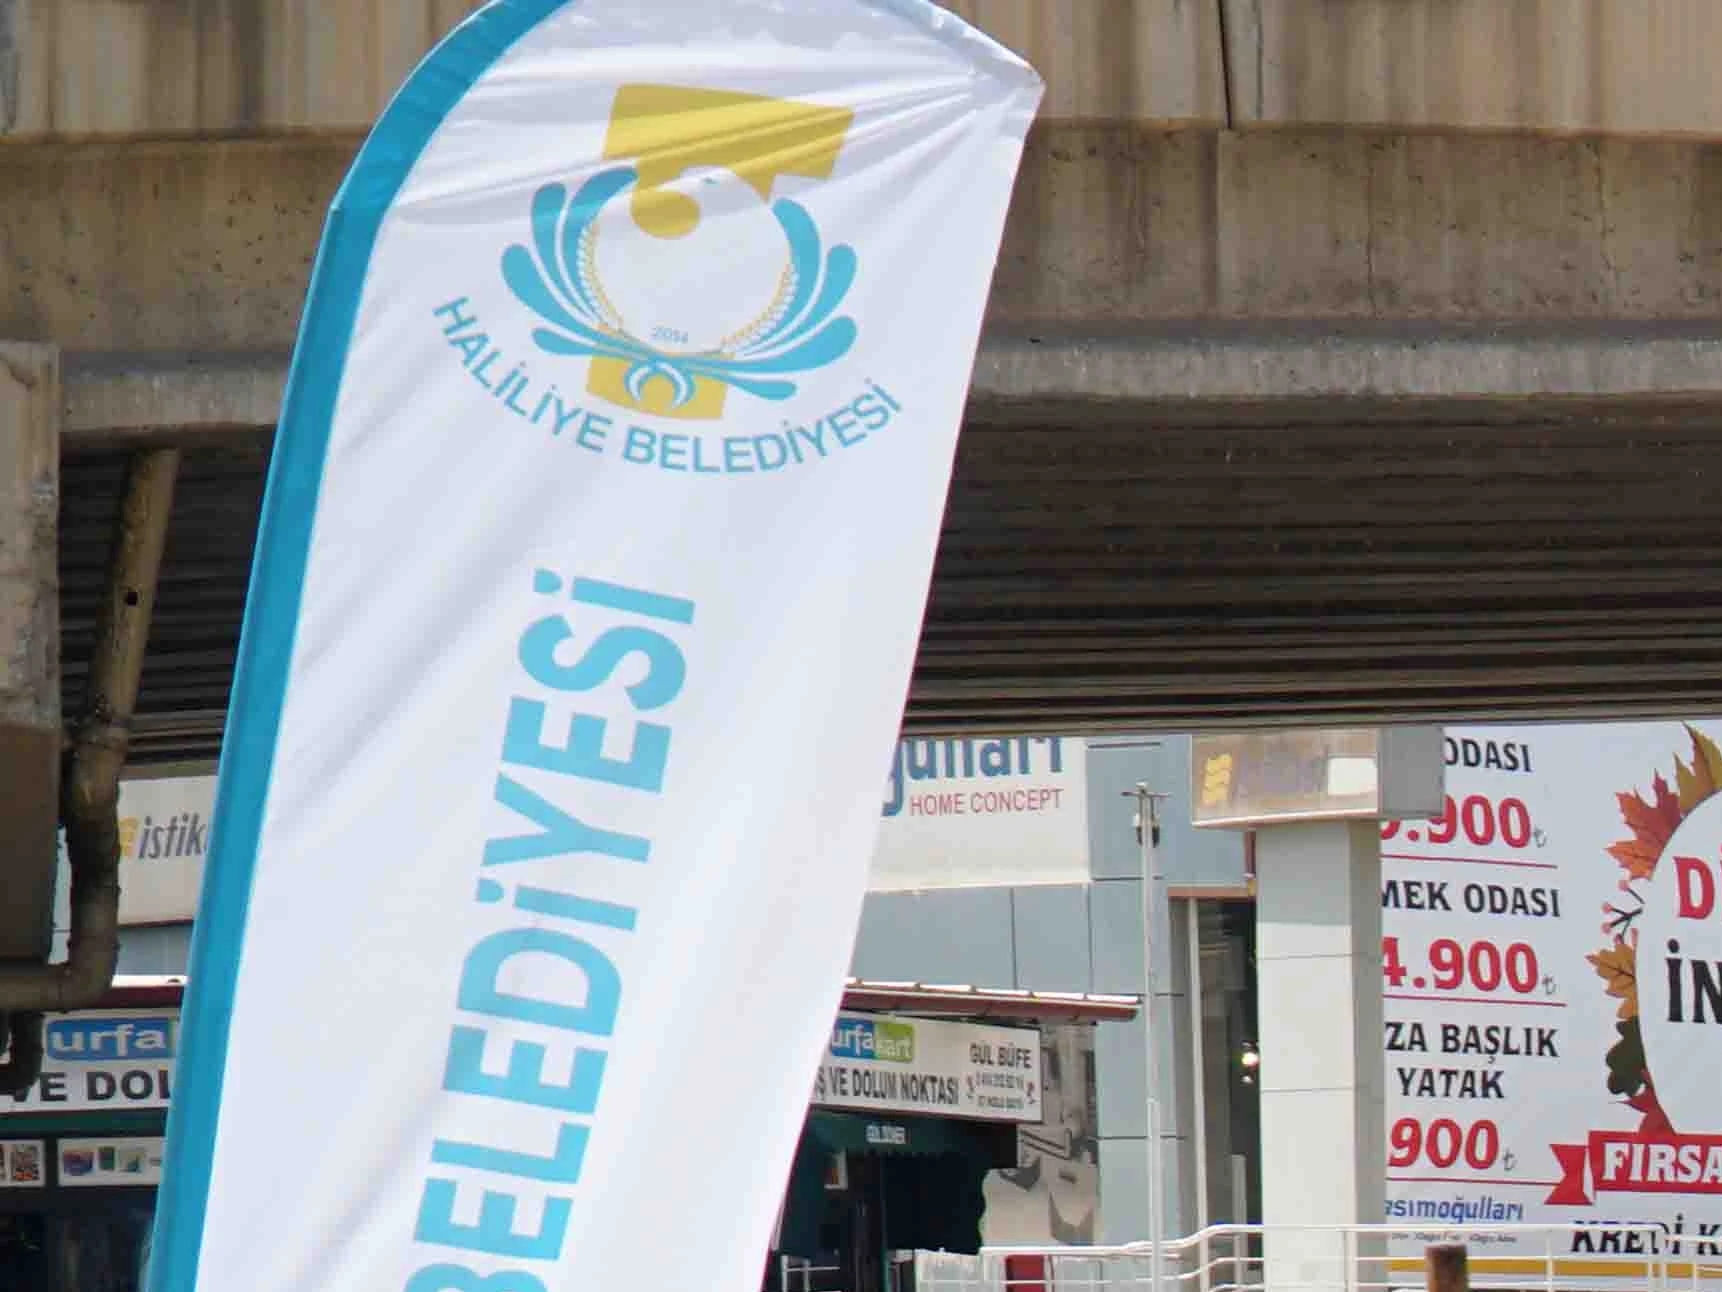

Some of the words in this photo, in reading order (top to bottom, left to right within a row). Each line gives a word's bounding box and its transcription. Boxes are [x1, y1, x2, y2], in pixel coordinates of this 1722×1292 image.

[651, 325, 690, 345] 2014
[432, 296, 613, 453] HALİLİYE
[622, 376, 902, 473] BELEDİYESİ
[909, 795, 964, 817] HOME
[970, 788, 1065, 814] CONCEPT
[138, 812, 210, 860] istik
[1463, 883, 1561, 918] ODASI
[1440, 1023, 1560, 1064] BAŞLIK
[829, 1068, 848, 1096] VE
[852, 1068, 897, 1100] DOLUM
[900, 1073, 960, 1106] NOKTASI
[1396, 1066, 1505, 1099] YATAK
[1385, 1194, 1523, 1224] sımoğulları
